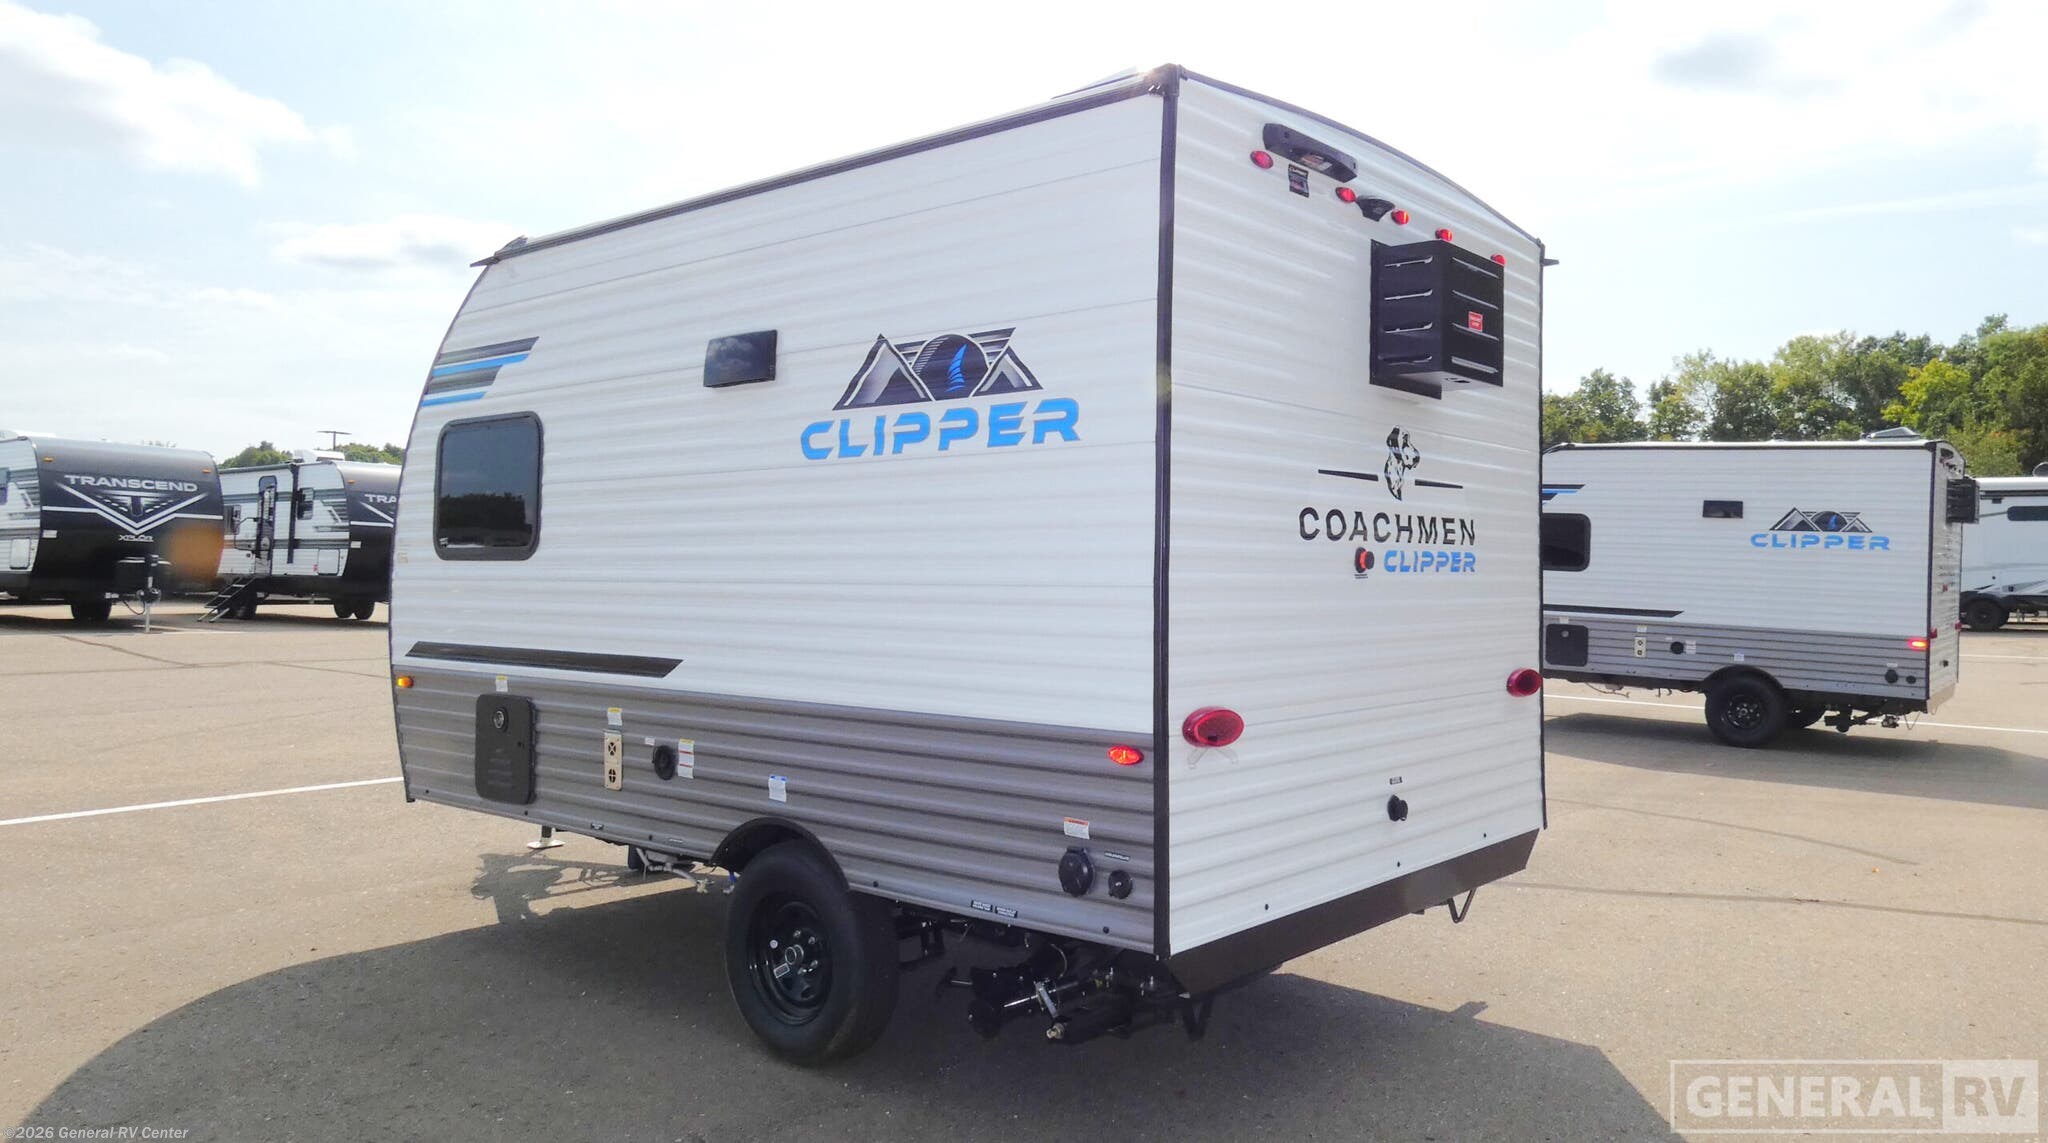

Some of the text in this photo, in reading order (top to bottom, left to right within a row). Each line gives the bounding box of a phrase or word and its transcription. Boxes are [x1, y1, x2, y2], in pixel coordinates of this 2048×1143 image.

[800, 397, 1081, 461] CLIPPER
[64, 474, 198, 492] TRANSCEND
[1298, 506, 1477, 546] COACHMEN
[1750, 532, 1890, 551] CLIPPER
[1383, 549, 1477, 574] CLIPPER
